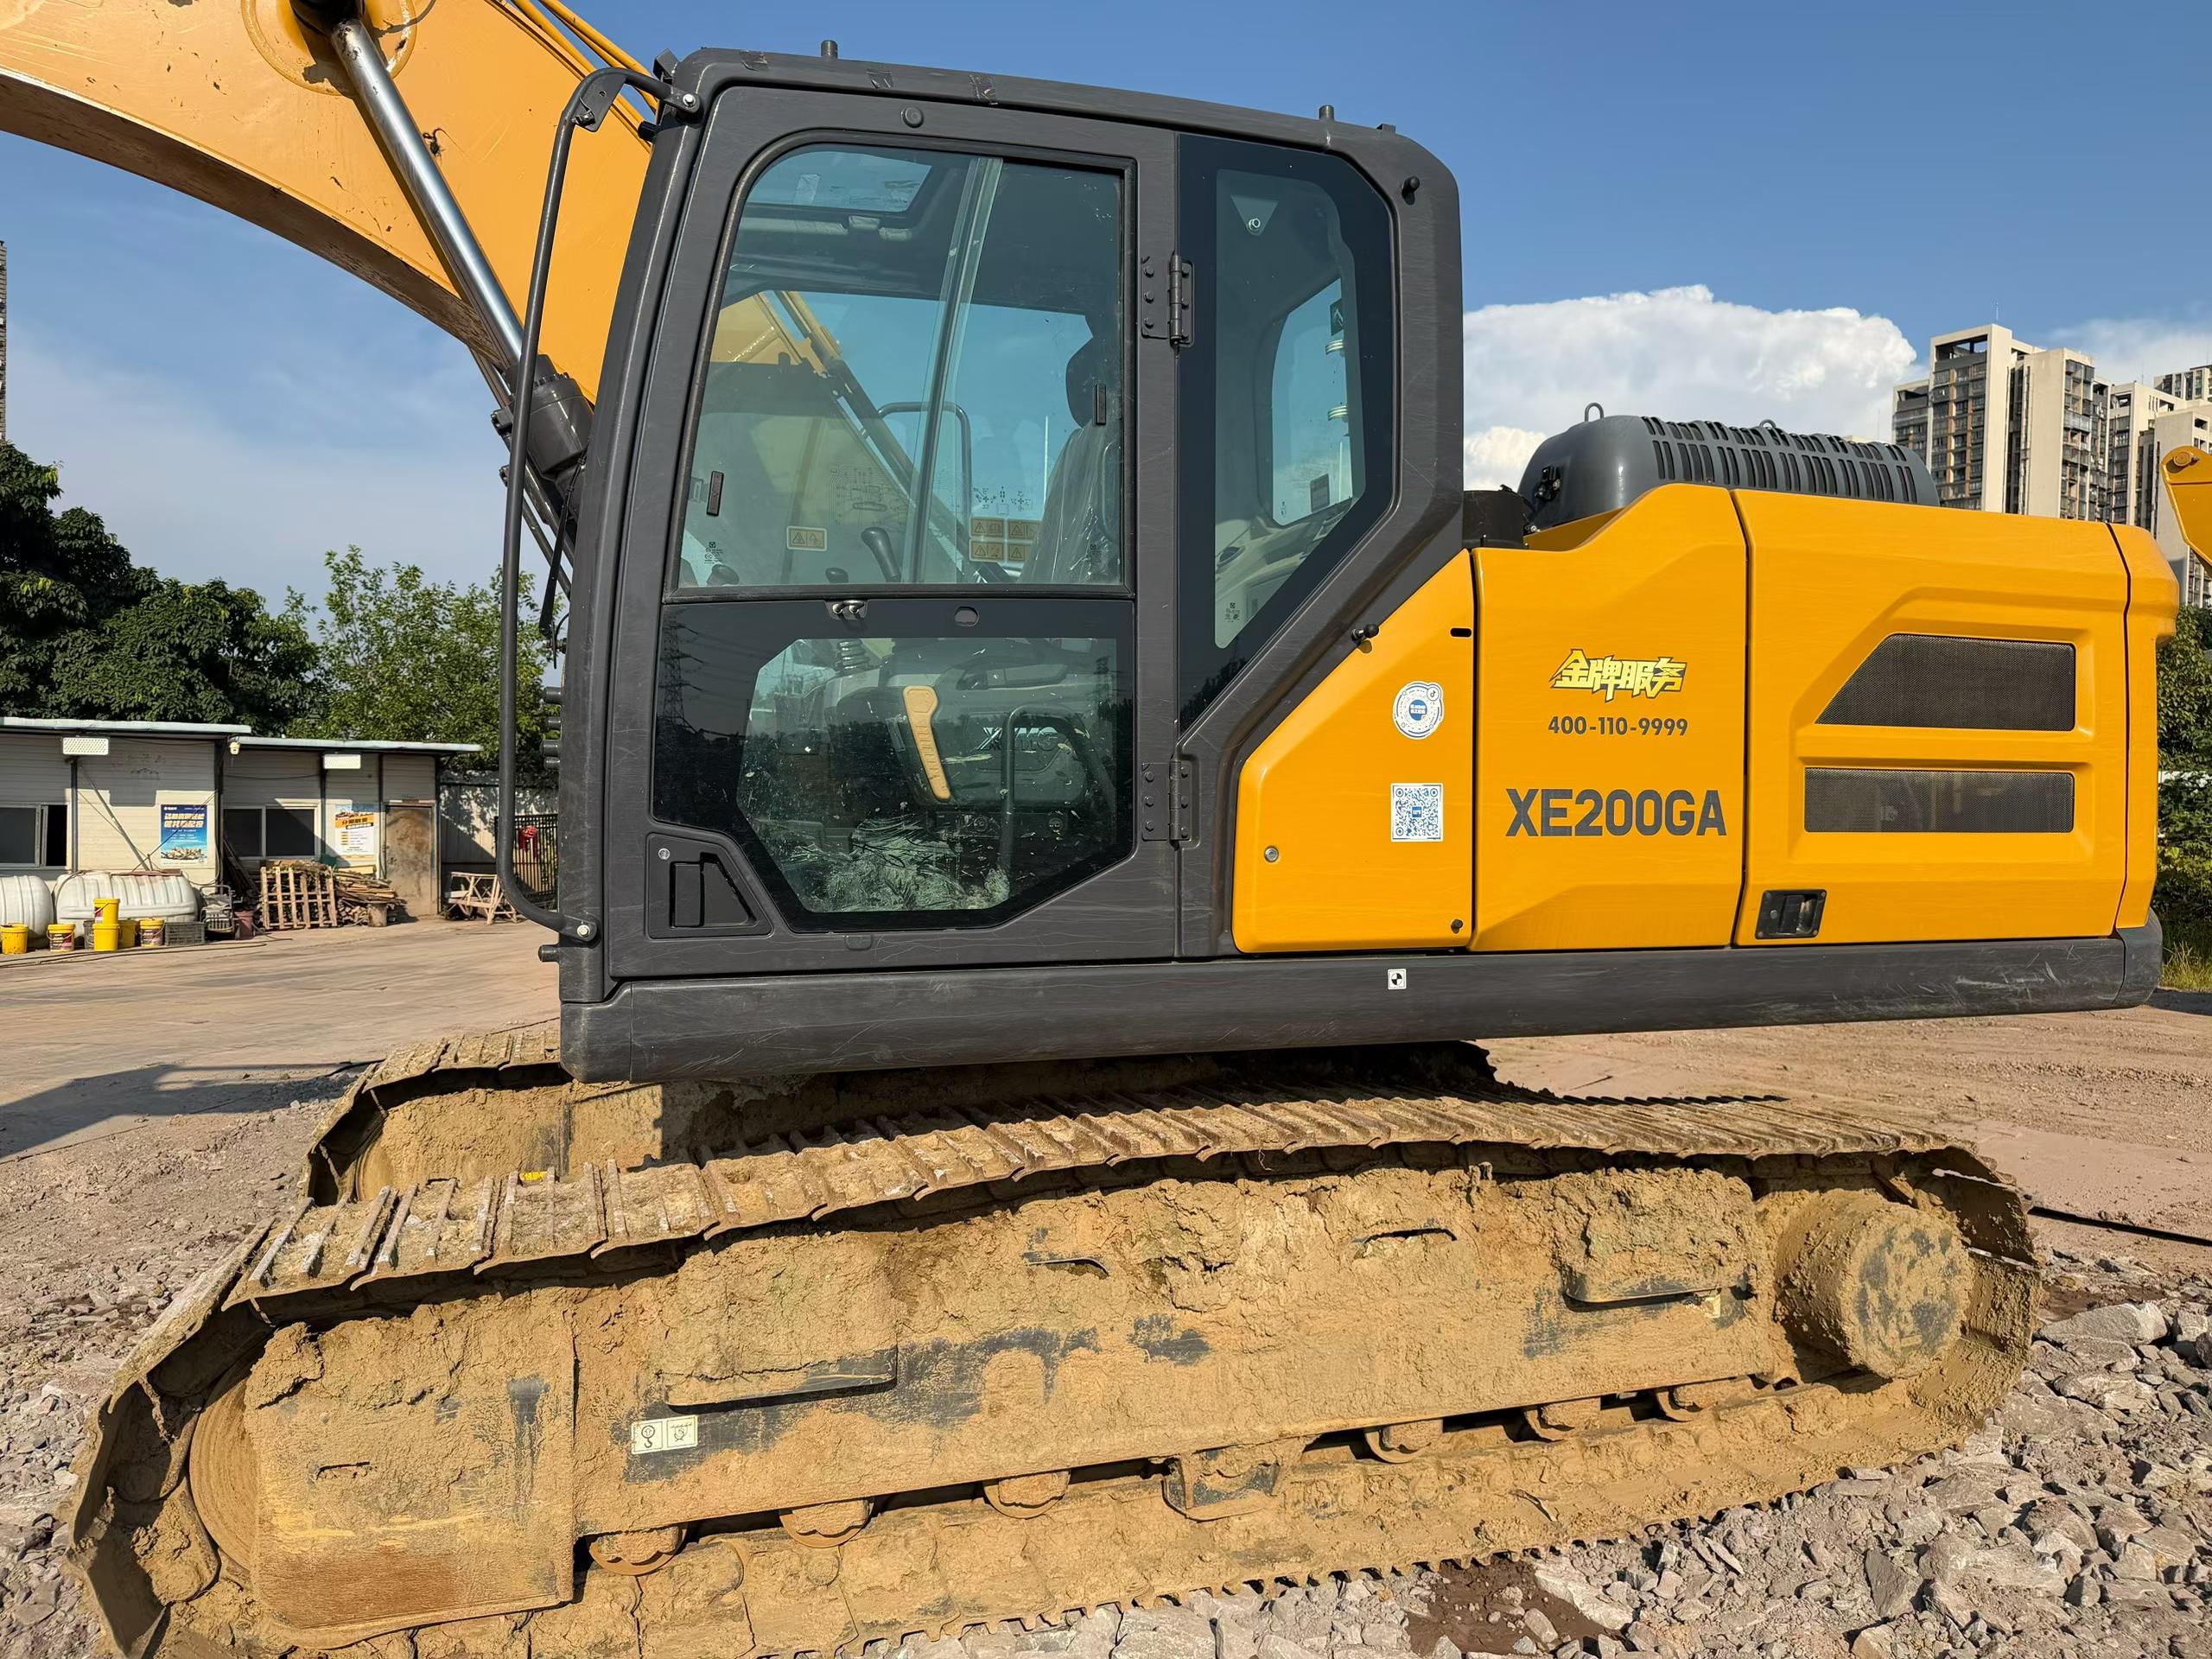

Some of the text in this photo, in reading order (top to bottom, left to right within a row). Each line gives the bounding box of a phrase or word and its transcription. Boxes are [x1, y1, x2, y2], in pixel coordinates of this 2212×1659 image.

[1549, 648, 1687, 702] 金牌服务
[976, 727, 1058, 751] XMG
[1548, 716, 1688, 735] 400-110-9999
[1506, 789, 1726, 836] XE200GA
